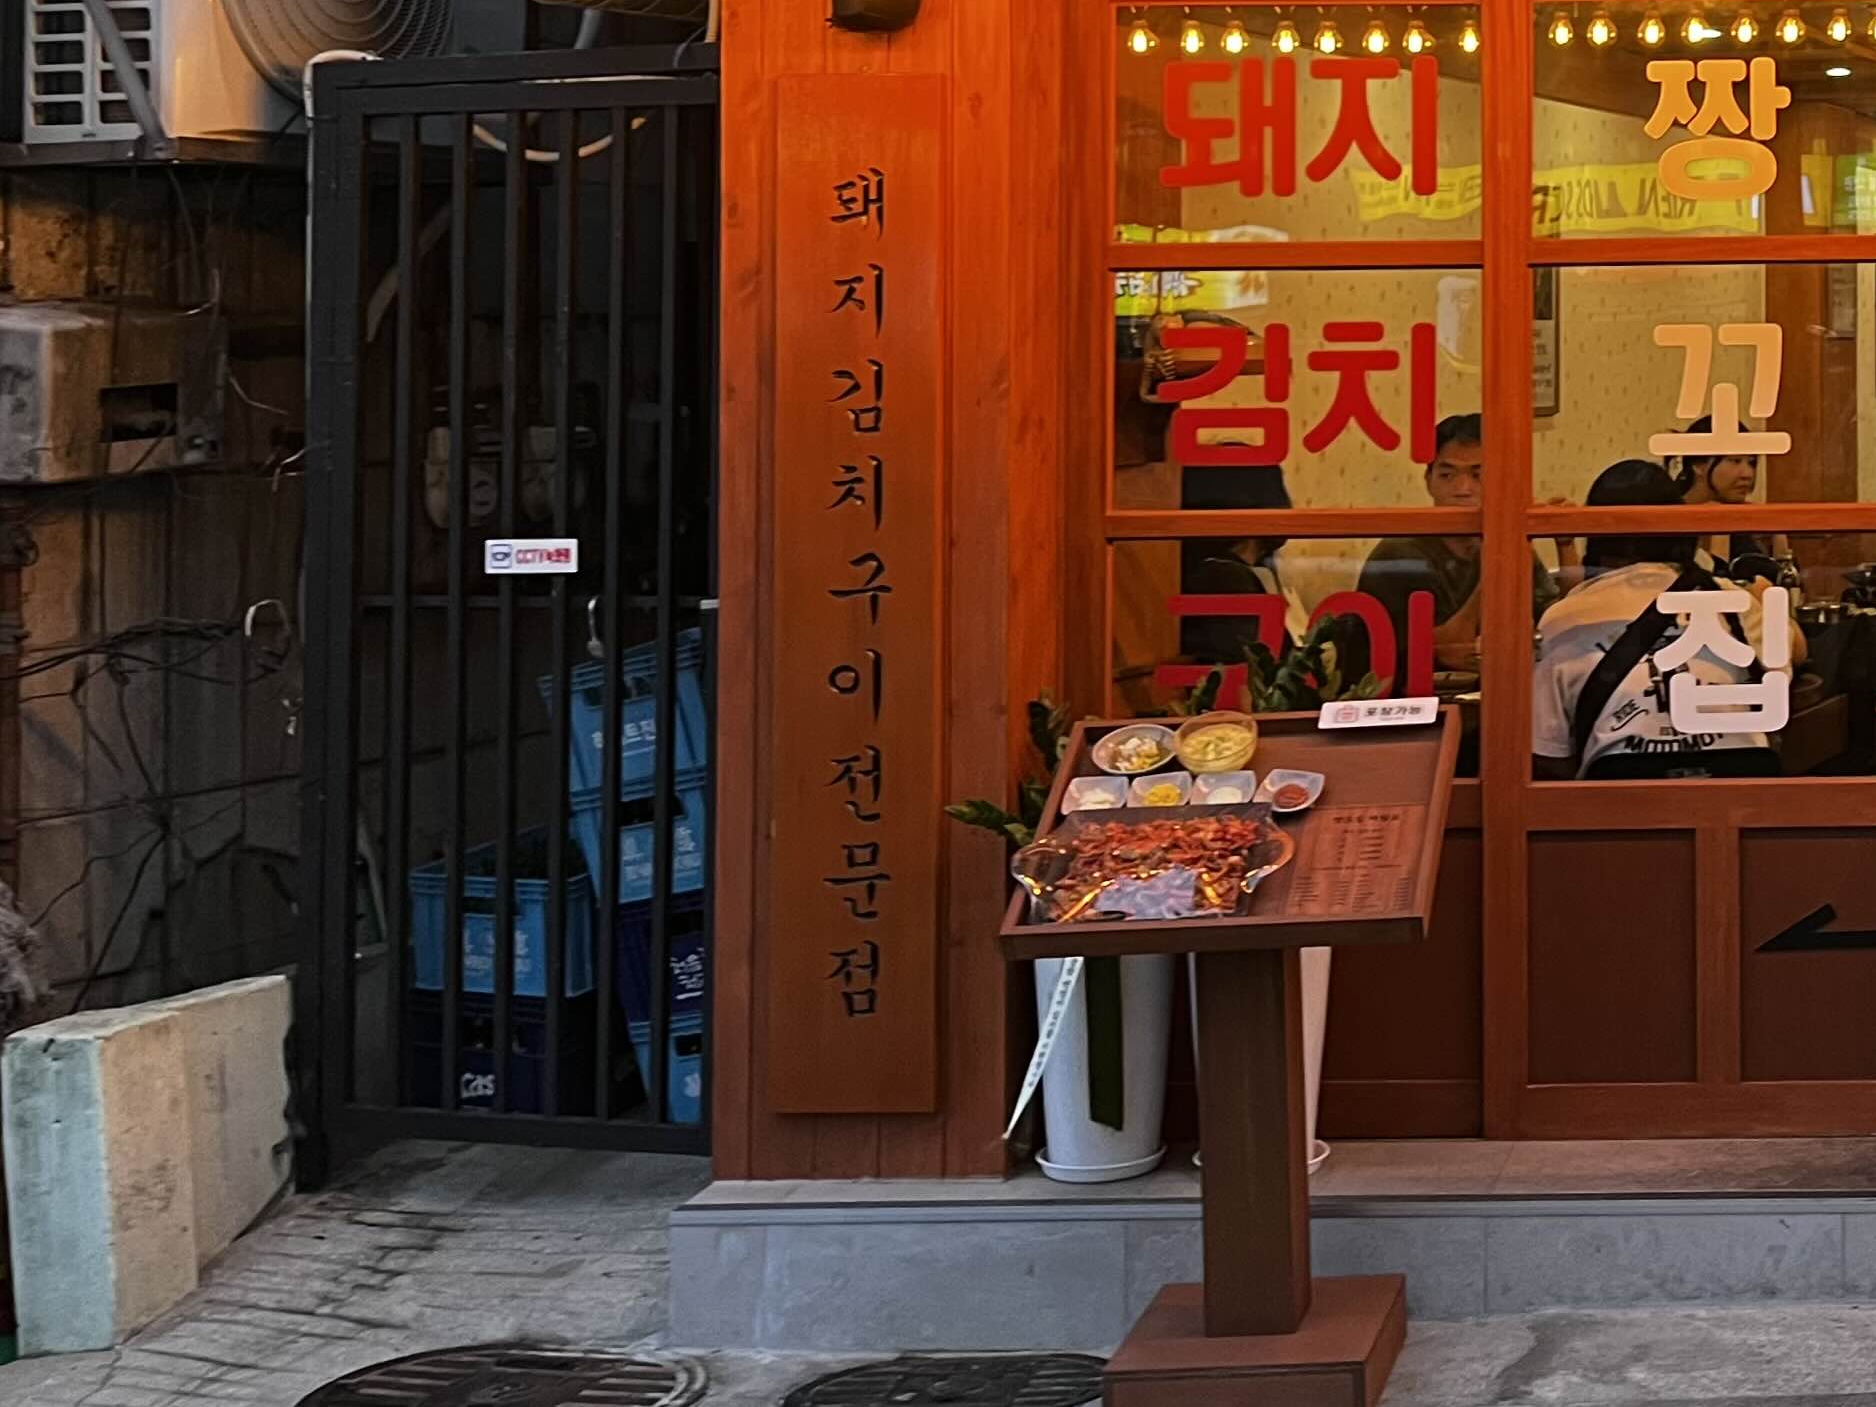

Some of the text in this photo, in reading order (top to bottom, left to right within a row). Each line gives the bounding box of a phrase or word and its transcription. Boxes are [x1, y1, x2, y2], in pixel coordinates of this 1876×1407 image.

[1157, 54, 1439, 197] 돼지
[1157, 320, 1438, 467] 김치
[823, 166, 892, 1017] 돼지김치구이전문점
